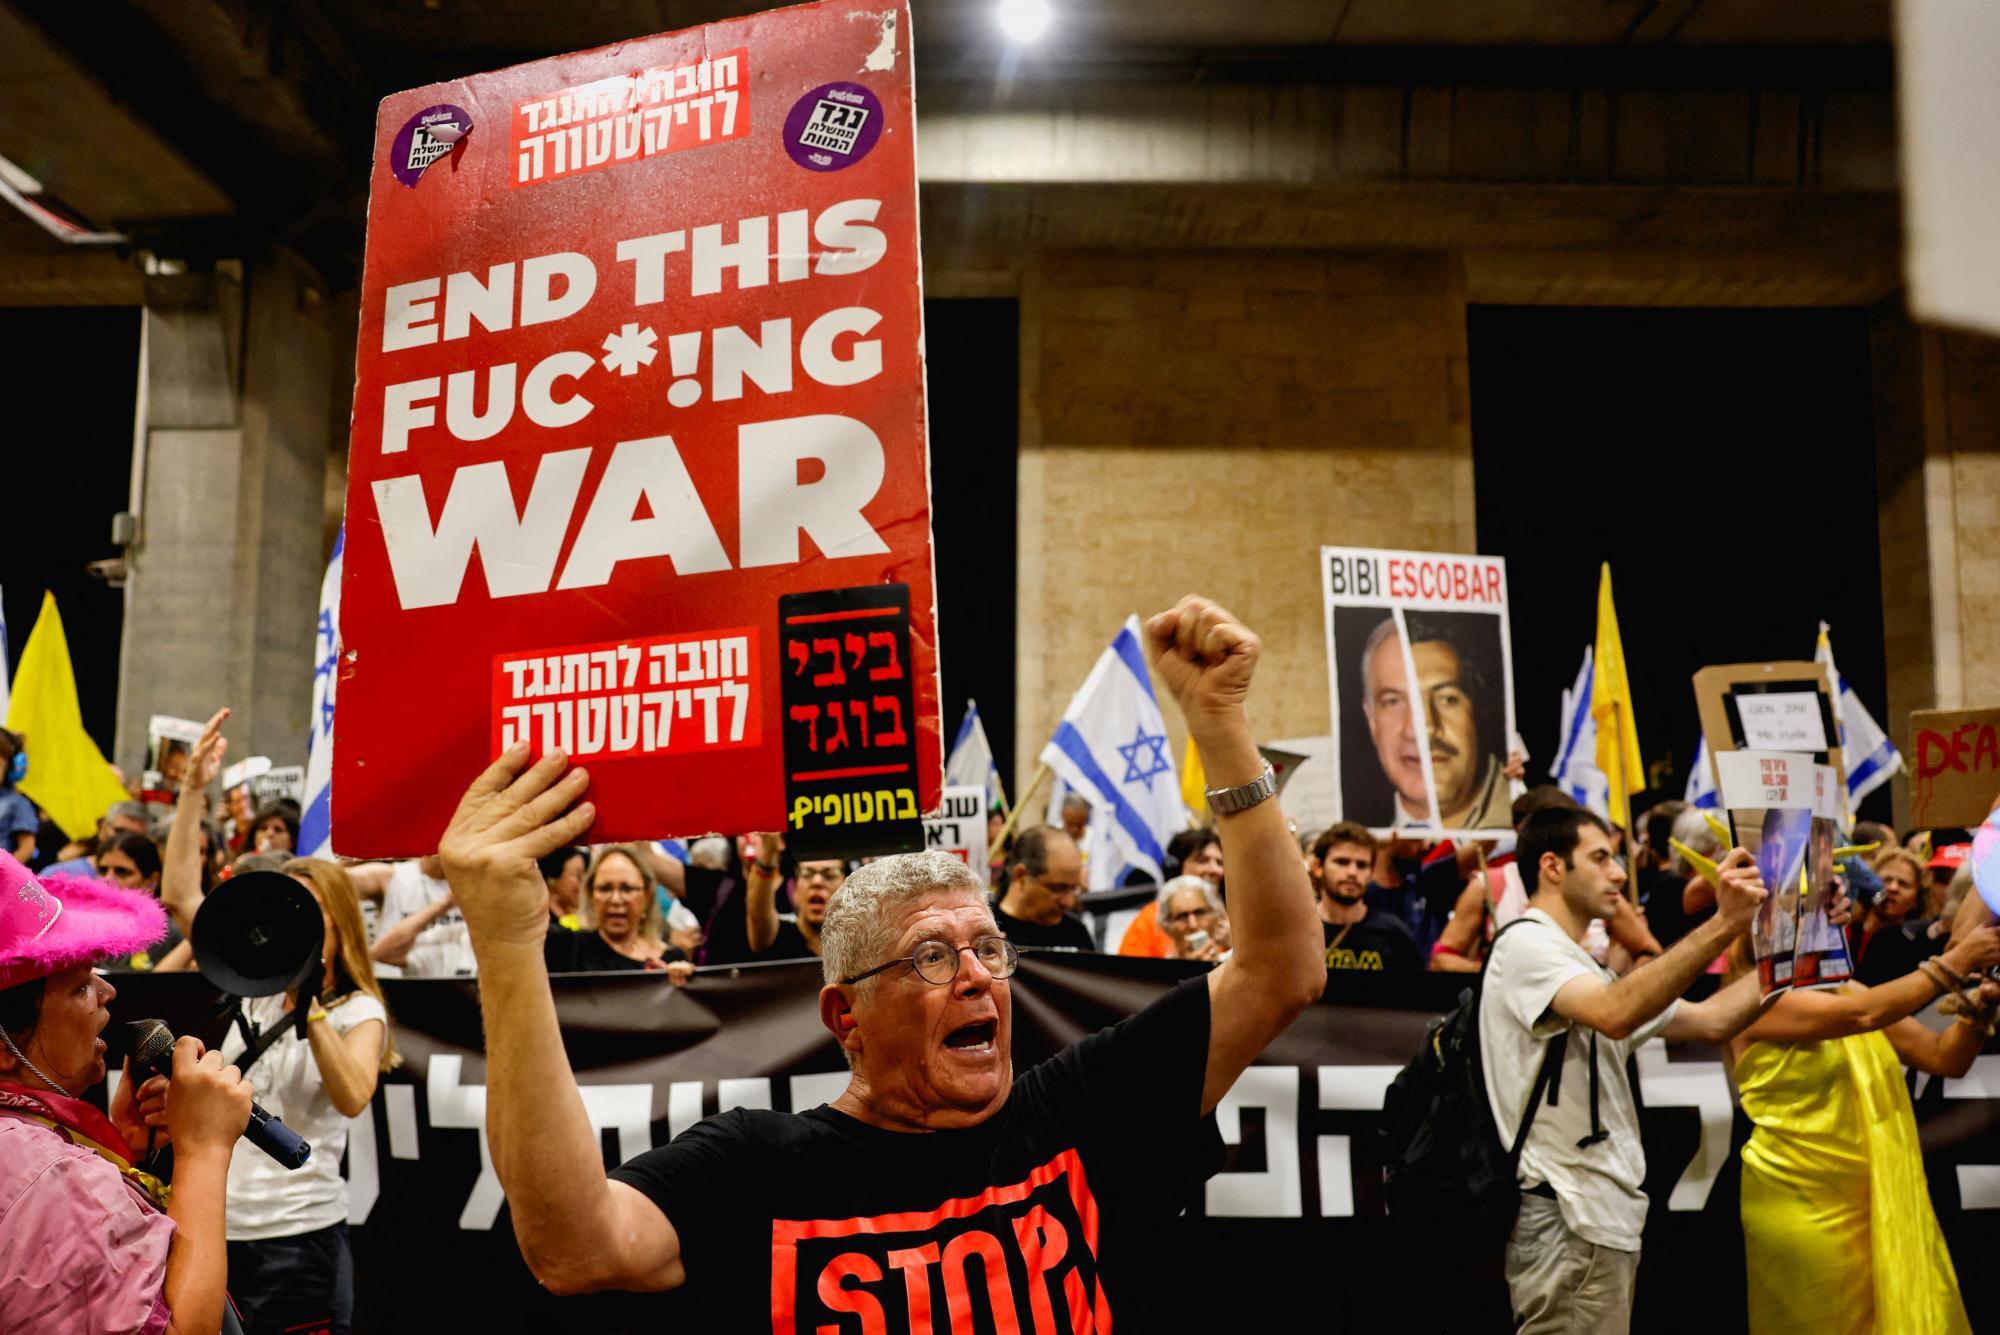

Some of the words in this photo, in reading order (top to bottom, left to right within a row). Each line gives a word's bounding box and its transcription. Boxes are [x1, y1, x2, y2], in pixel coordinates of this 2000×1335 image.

[649, 55, 738, 104] חובה
[518, 90, 738, 182] לדיקטטורה
[803, 132, 850, 151] המוות
[809, 122, 855, 139] ממשלת
[820, 103, 864, 129] נגד
[382, 252, 597, 353] END
[616, 198, 888, 307] THIS
[370, 414, 891, 610] WAR
[1330, 556, 1379, 596] BIBI
[1387, 559, 1501, 603] ESCOBAR
[503, 644, 641, 699] להתנגד
[649, 636, 748, 685] חובה
[788, 631, 903, 687] ביבי
[502, 680, 749, 757] לדיקטטורה
[790, 695, 907, 754] בוגד
